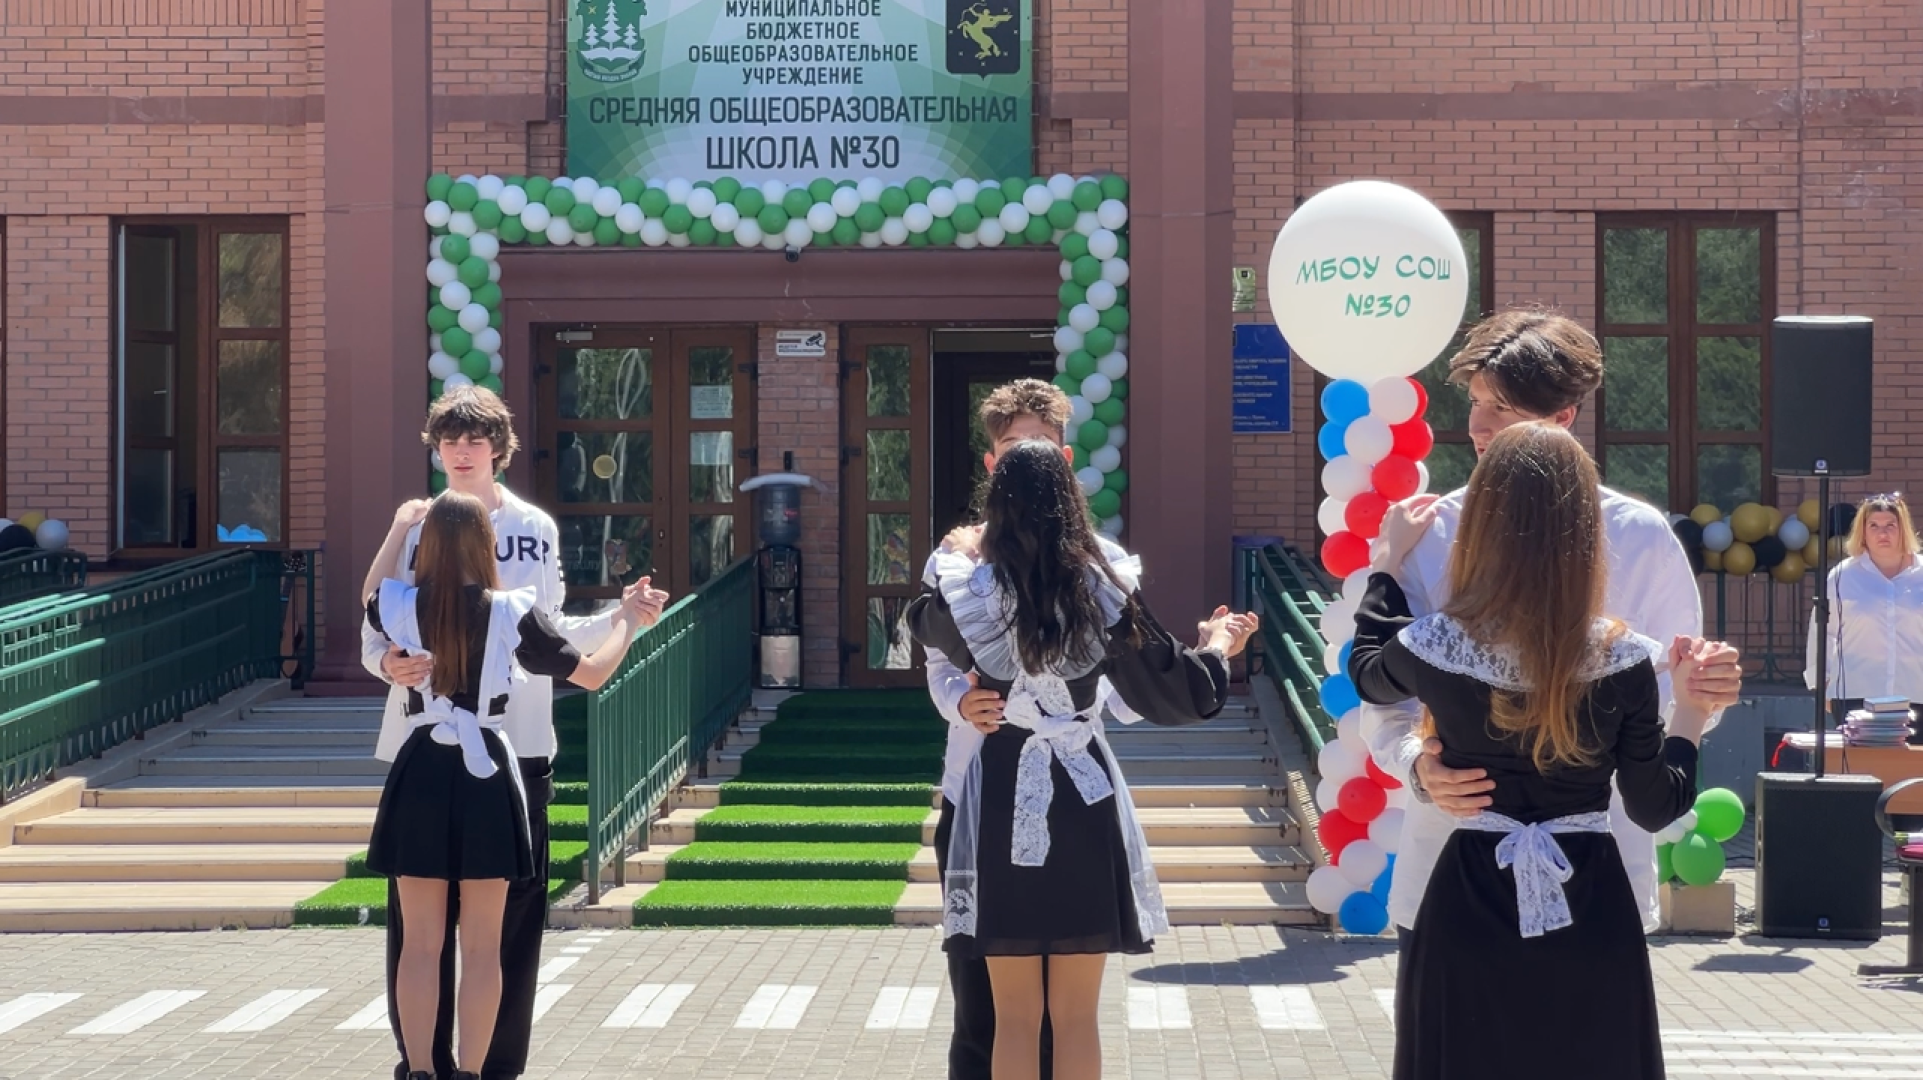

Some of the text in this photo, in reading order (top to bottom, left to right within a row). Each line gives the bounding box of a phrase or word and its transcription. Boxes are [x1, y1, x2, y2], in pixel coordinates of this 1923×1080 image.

[726, 0, 881, 17] МУНИЦИПАЛЬНОЕ
[746, 22, 860, 41] БЮДЖЕТНОЕ
[688, 44, 918, 64] ОБЩЕОБРАЗОВАТЕЛЬНОЕ
[742, 67, 864, 86] УЧРЕЖДЕНИЕ
[589, 96, 1018, 126] СРЕДНЯЯ ОБЩЕОБРАЗОВАТЕЛЬНАЯ
[706, 135, 900, 169] ШКОЛА №30
[1296, 254, 1451, 285] МБОУ СОШ
[1345, 292, 1411, 318] №30
